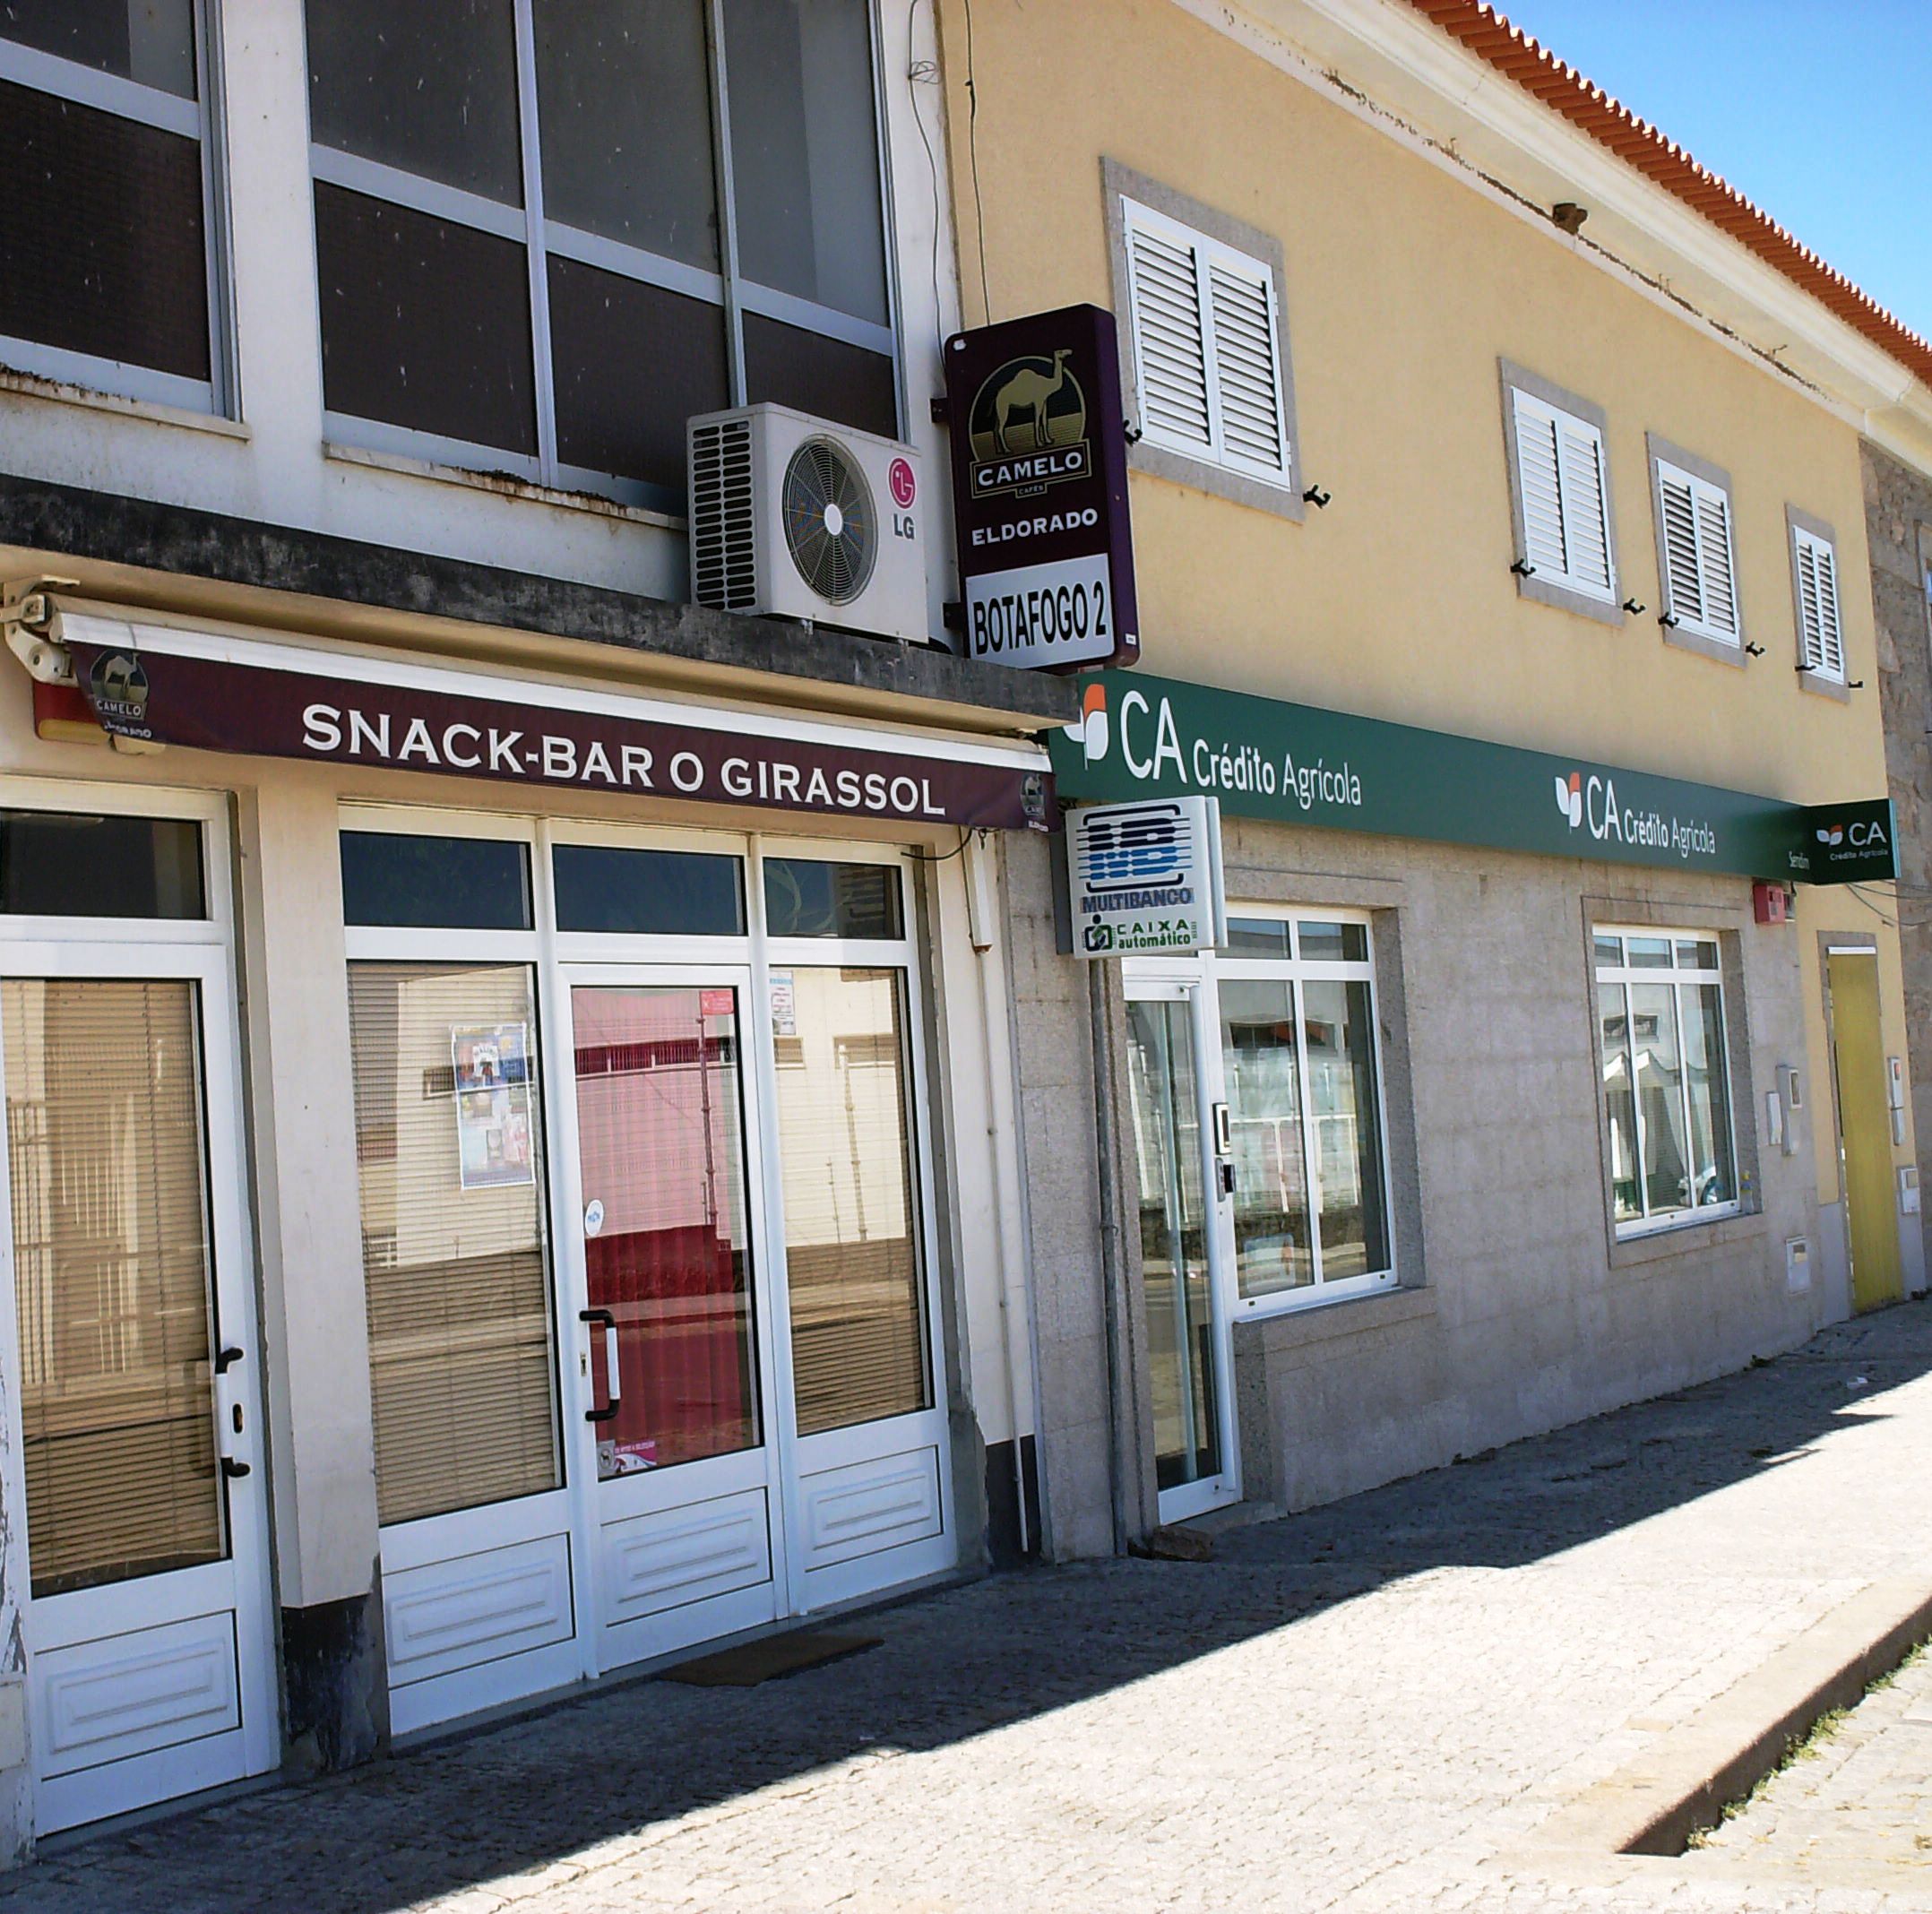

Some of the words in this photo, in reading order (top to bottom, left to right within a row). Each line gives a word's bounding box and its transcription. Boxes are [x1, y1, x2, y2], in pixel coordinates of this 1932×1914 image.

[978, 452, 1082, 487] CAMELO
[893, 513, 915, 540] LG
[971, 508, 1099, 547] ELDORADO
[972, 582, 1088, 655] BOTAFOGO
[1093, 580, 1107, 636] 2
[97, 700, 141, 715] CAMELO
[302, 703, 655, 789] SNACK-BAR
[669, 751, 705, 792] O
[720, 757, 946, 817] GIRASSOL
[1120, 690, 1188, 784] CA
[1194, 737, 1276, 796] Crédito
[1282, 753, 1362, 810] Agrícola
[1587, 775, 1623, 842] CA
[1625, 808, 1669, 849] Crédito
[1672, 816, 1716, 858] Agrícola
[1849, 821, 1887, 846] CA
[1082, 887, 1193, 913] MULTIBANCO
[1117, 918, 1189, 935] CAIXA
[1118, 931, 1191, 950] automático
